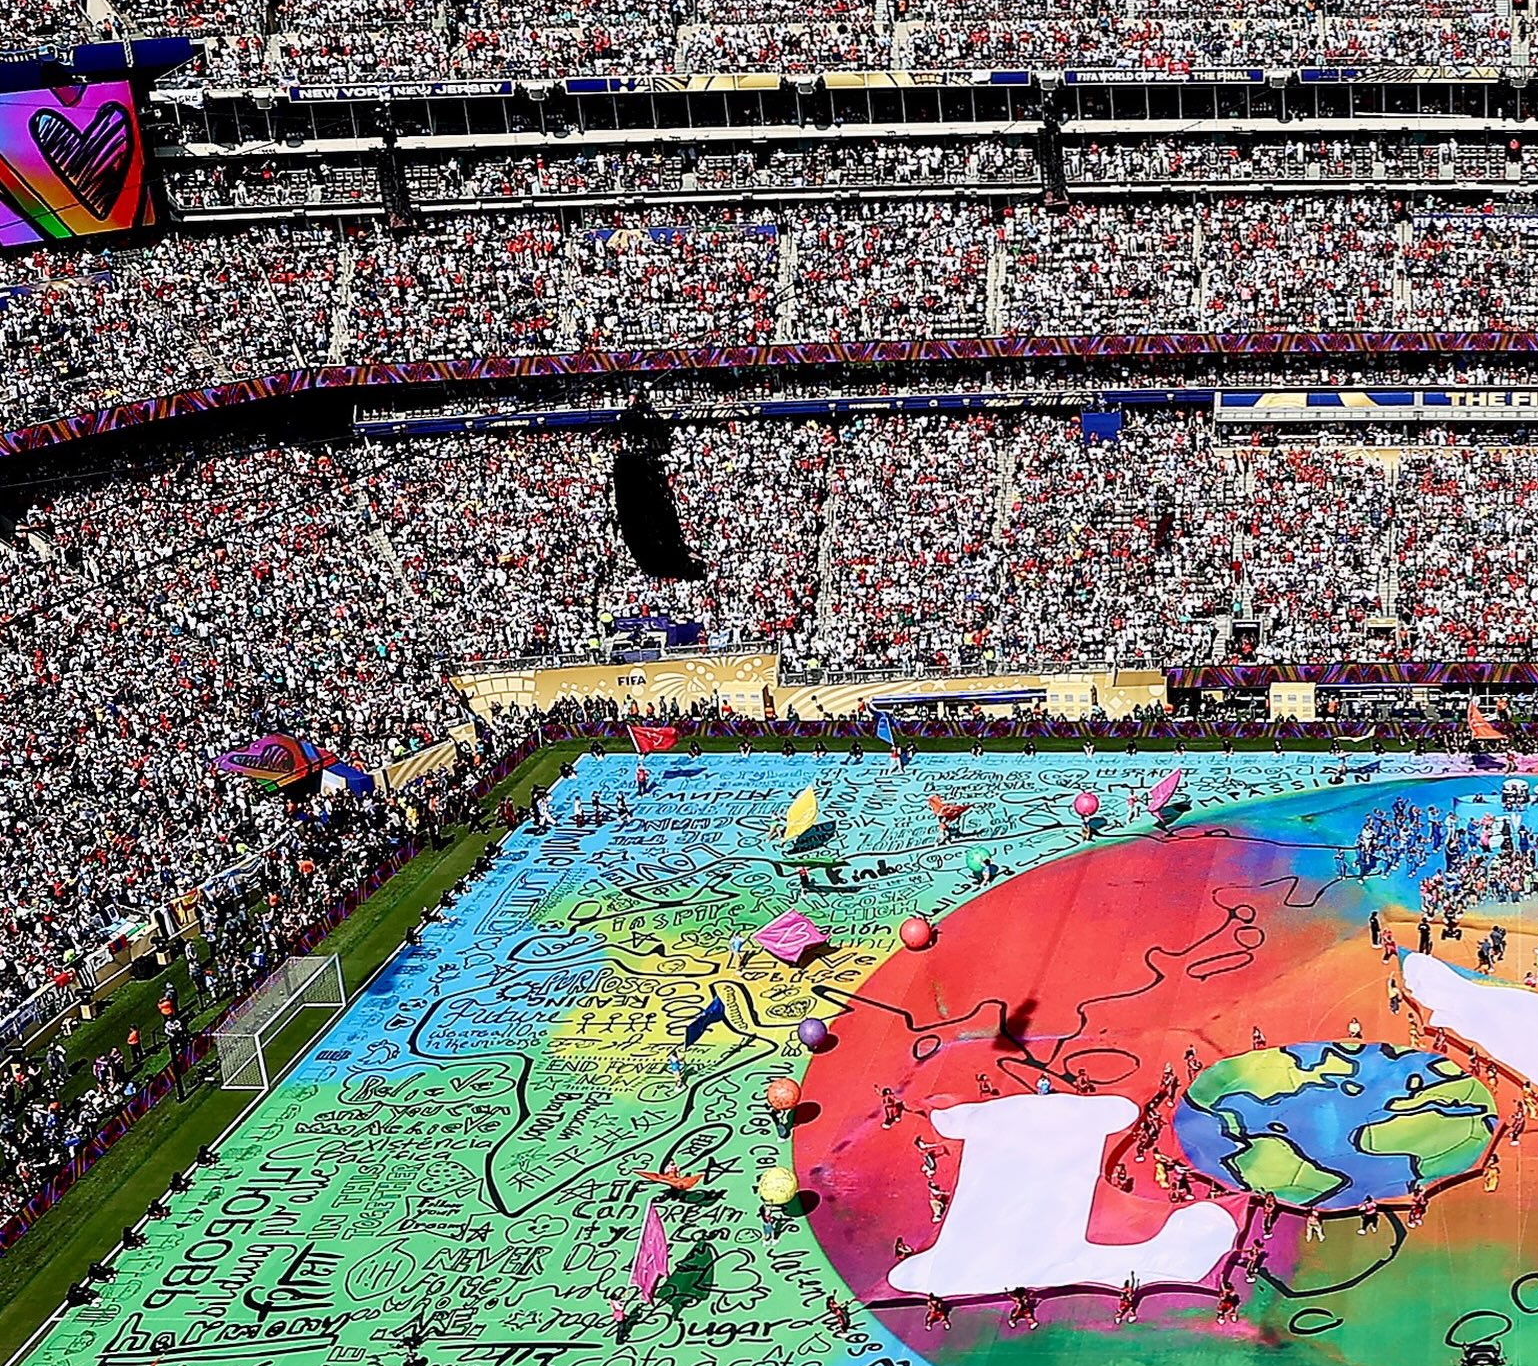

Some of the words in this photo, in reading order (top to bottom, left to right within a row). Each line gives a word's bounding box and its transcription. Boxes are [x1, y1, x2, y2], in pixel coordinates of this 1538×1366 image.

[298, 88, 338, 99] NEW
[434, 84, 502, 98] JERSEY
[1446, 391, 1507, 407] THE
[617, 675, 646, 686] FIFA
